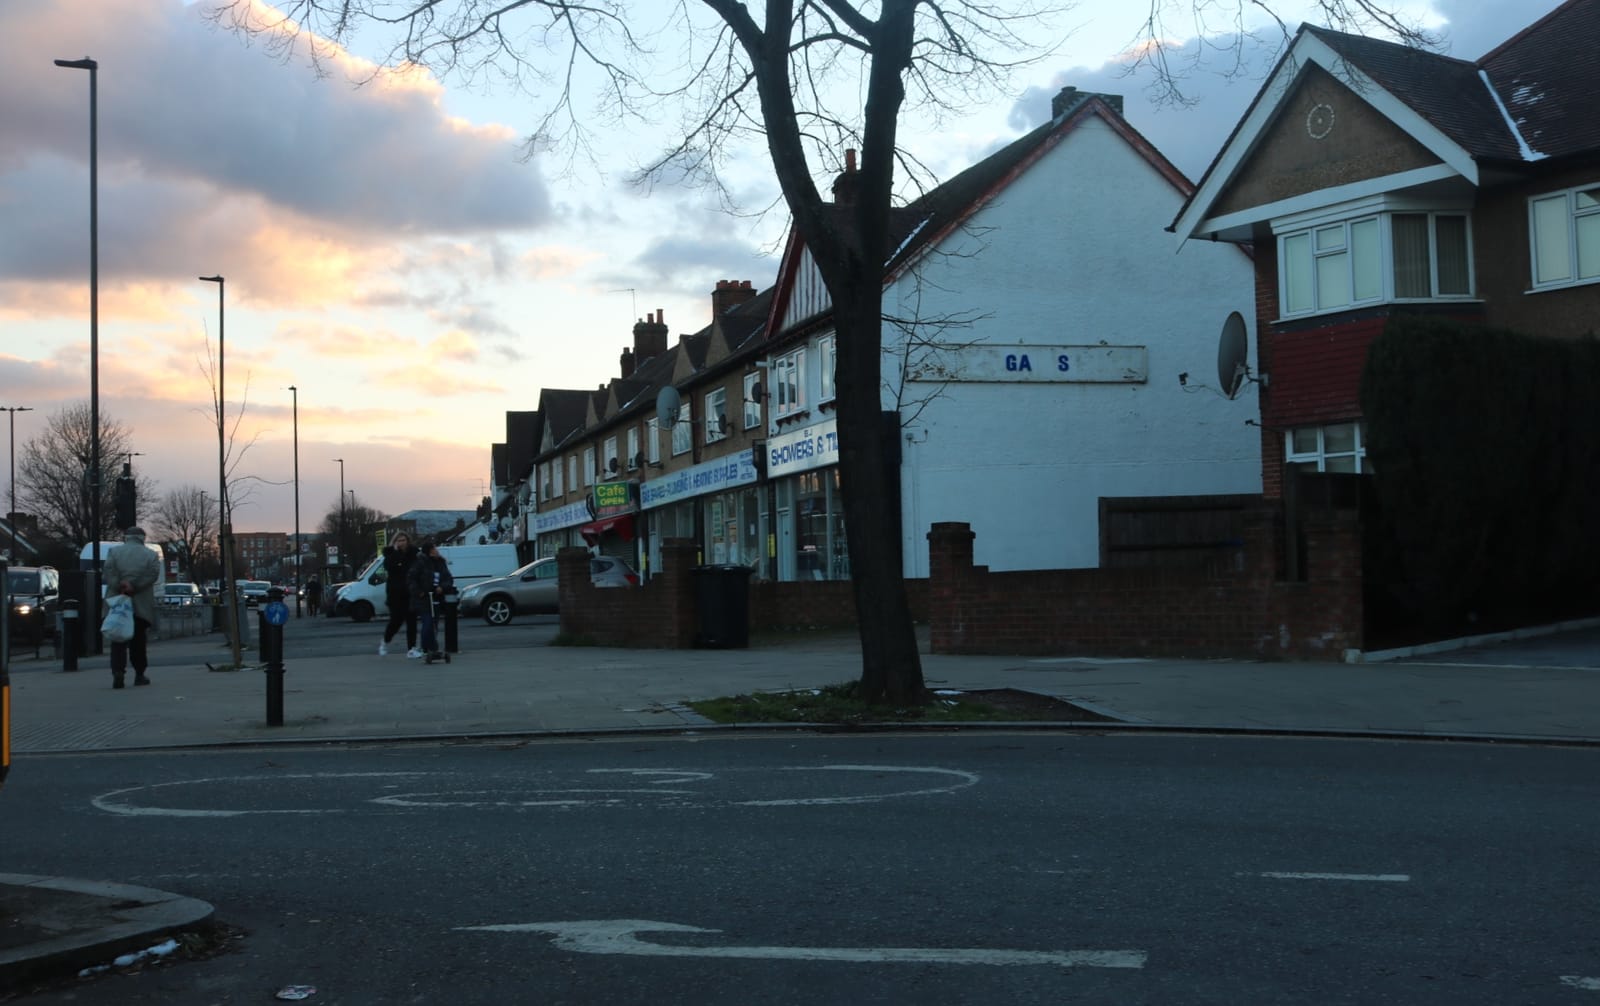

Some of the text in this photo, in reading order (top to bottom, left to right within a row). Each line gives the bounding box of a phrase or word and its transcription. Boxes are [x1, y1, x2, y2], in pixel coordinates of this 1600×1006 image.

[1006, 354, 1069, 372] GA S
[771, 439, 813, 467] SHOWERS
[817, 435, 824, 454] &
[597, 485, 625, 497] Cafe
[600, 497, 625, 506] OPEN
